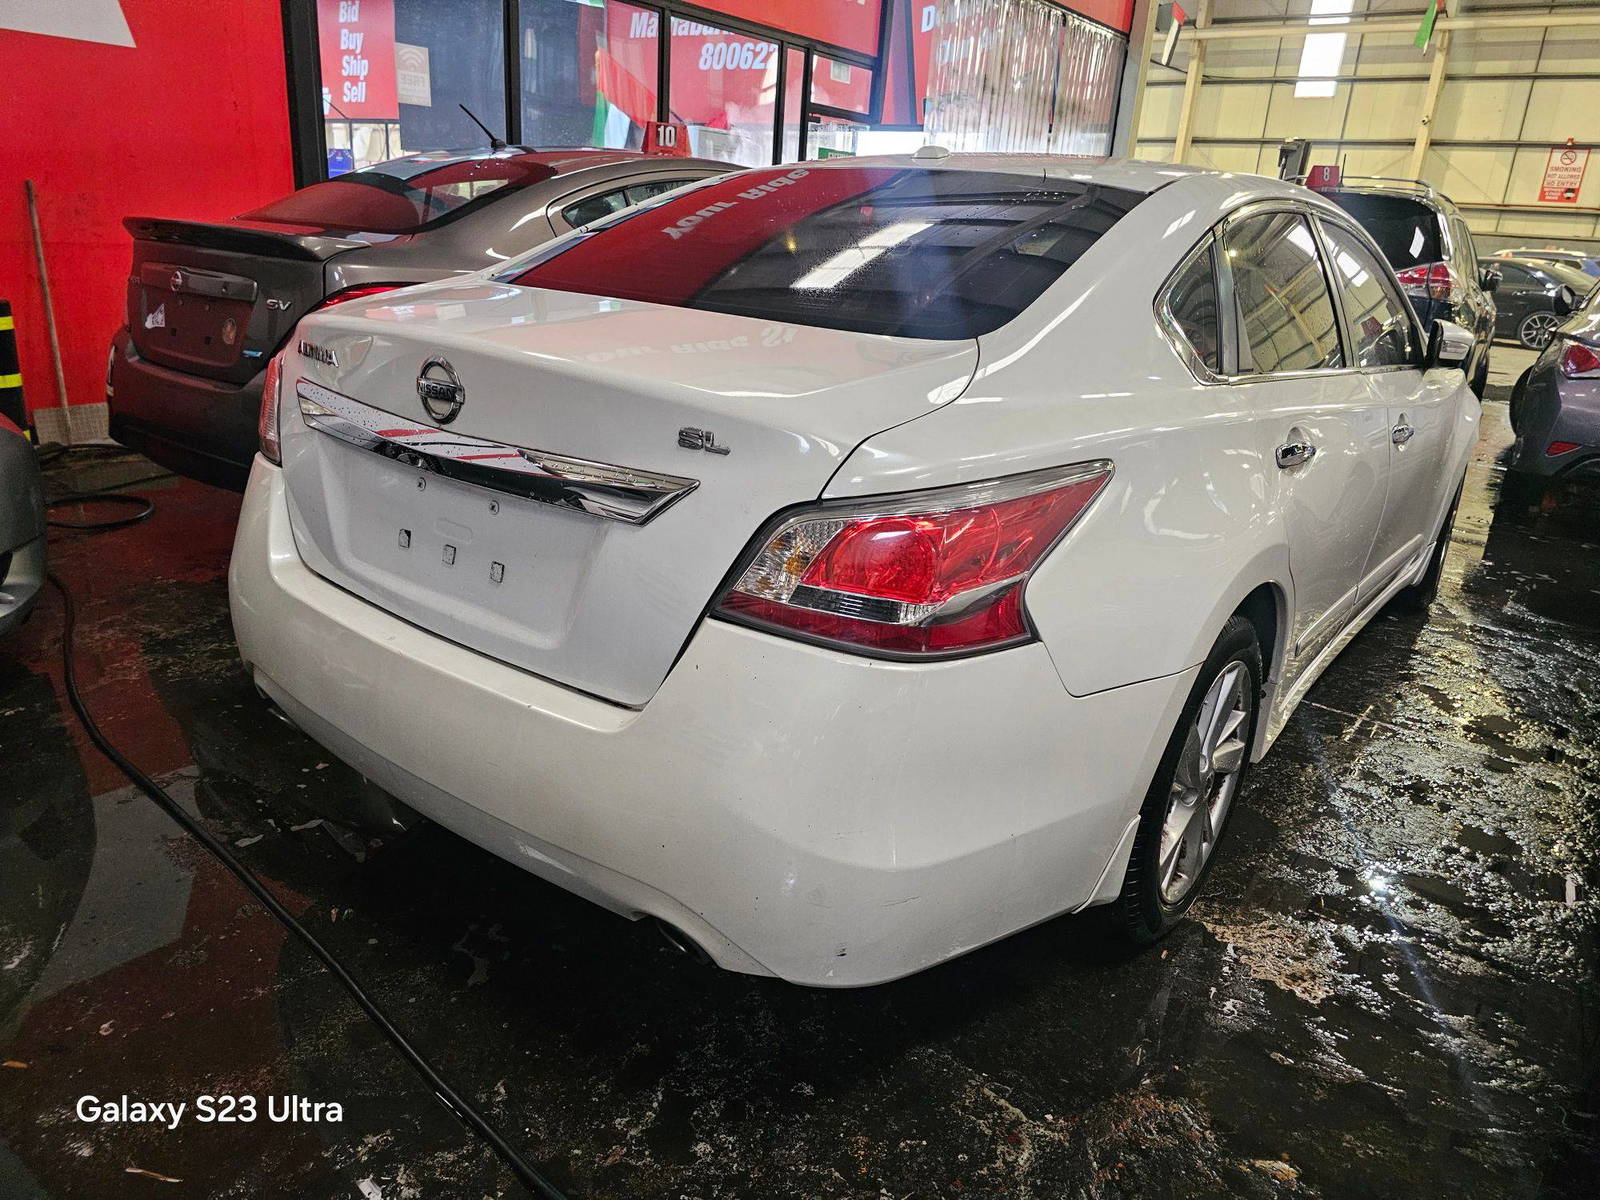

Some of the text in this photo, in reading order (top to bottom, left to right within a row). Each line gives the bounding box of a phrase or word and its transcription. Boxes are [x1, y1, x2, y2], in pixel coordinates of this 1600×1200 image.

[339, 0, 360, 23] Bid
[340, 28, 364, 54] Buy
[341, 54, 369, 81] Ship
[343, 81, 366, 103] Sell
[657, 125, 676, 148] 10
[1323, 166, 1330, 182] 8
[266, 299, 292, 312] SV
[418, 378, 458, 402] NISSAN
[677, 426, 731, 456] SL
